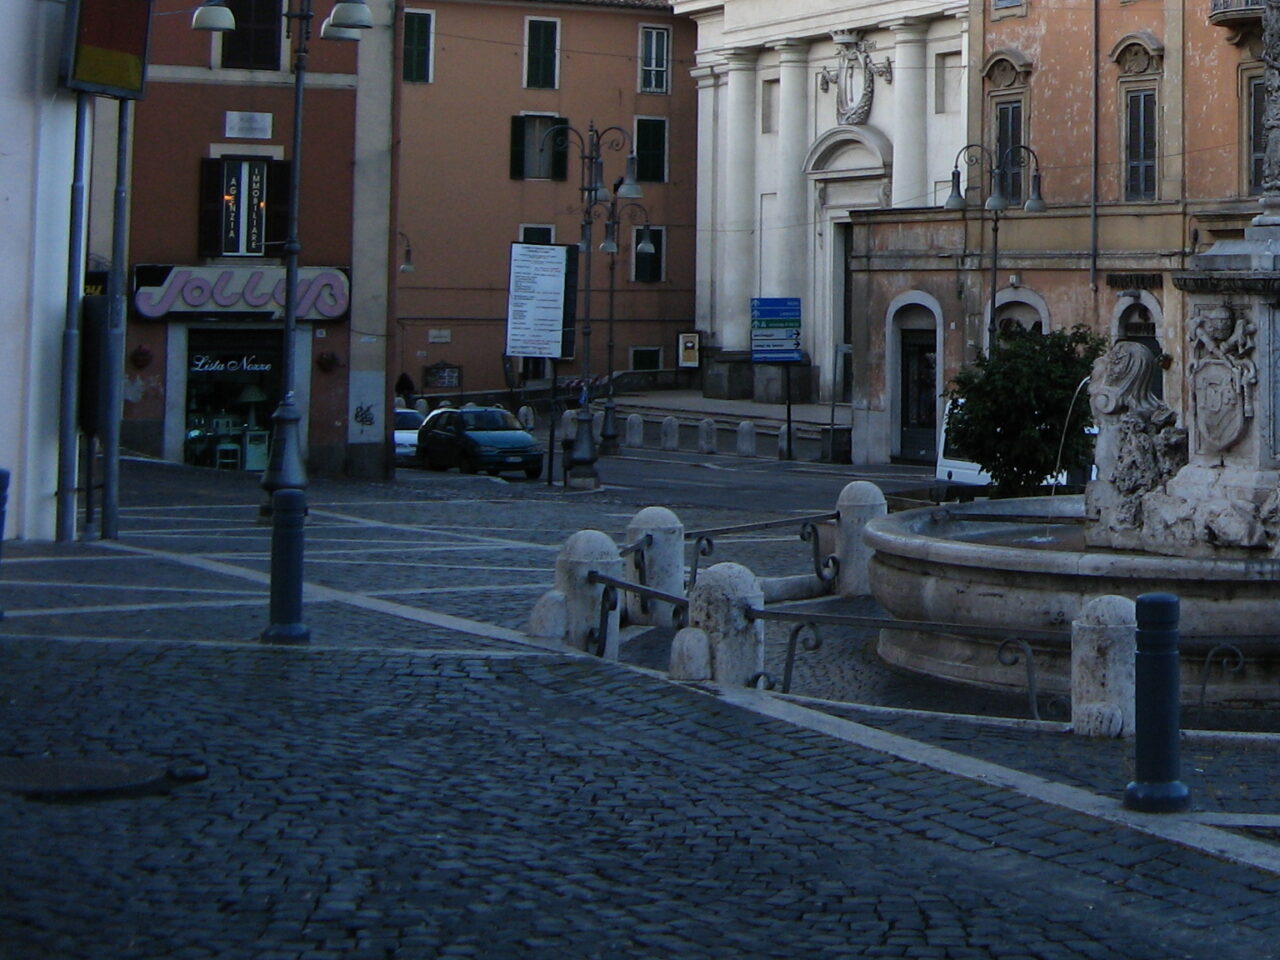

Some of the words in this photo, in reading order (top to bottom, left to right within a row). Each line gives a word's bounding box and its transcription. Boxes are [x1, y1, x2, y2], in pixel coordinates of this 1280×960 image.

[229, 177, 238, 238] AGENZIA
[251, 167, 261, 249] IMMOBILIARE
[191, 354, 225, 371] Lista
[227, 354, 272, 371] Nozze
